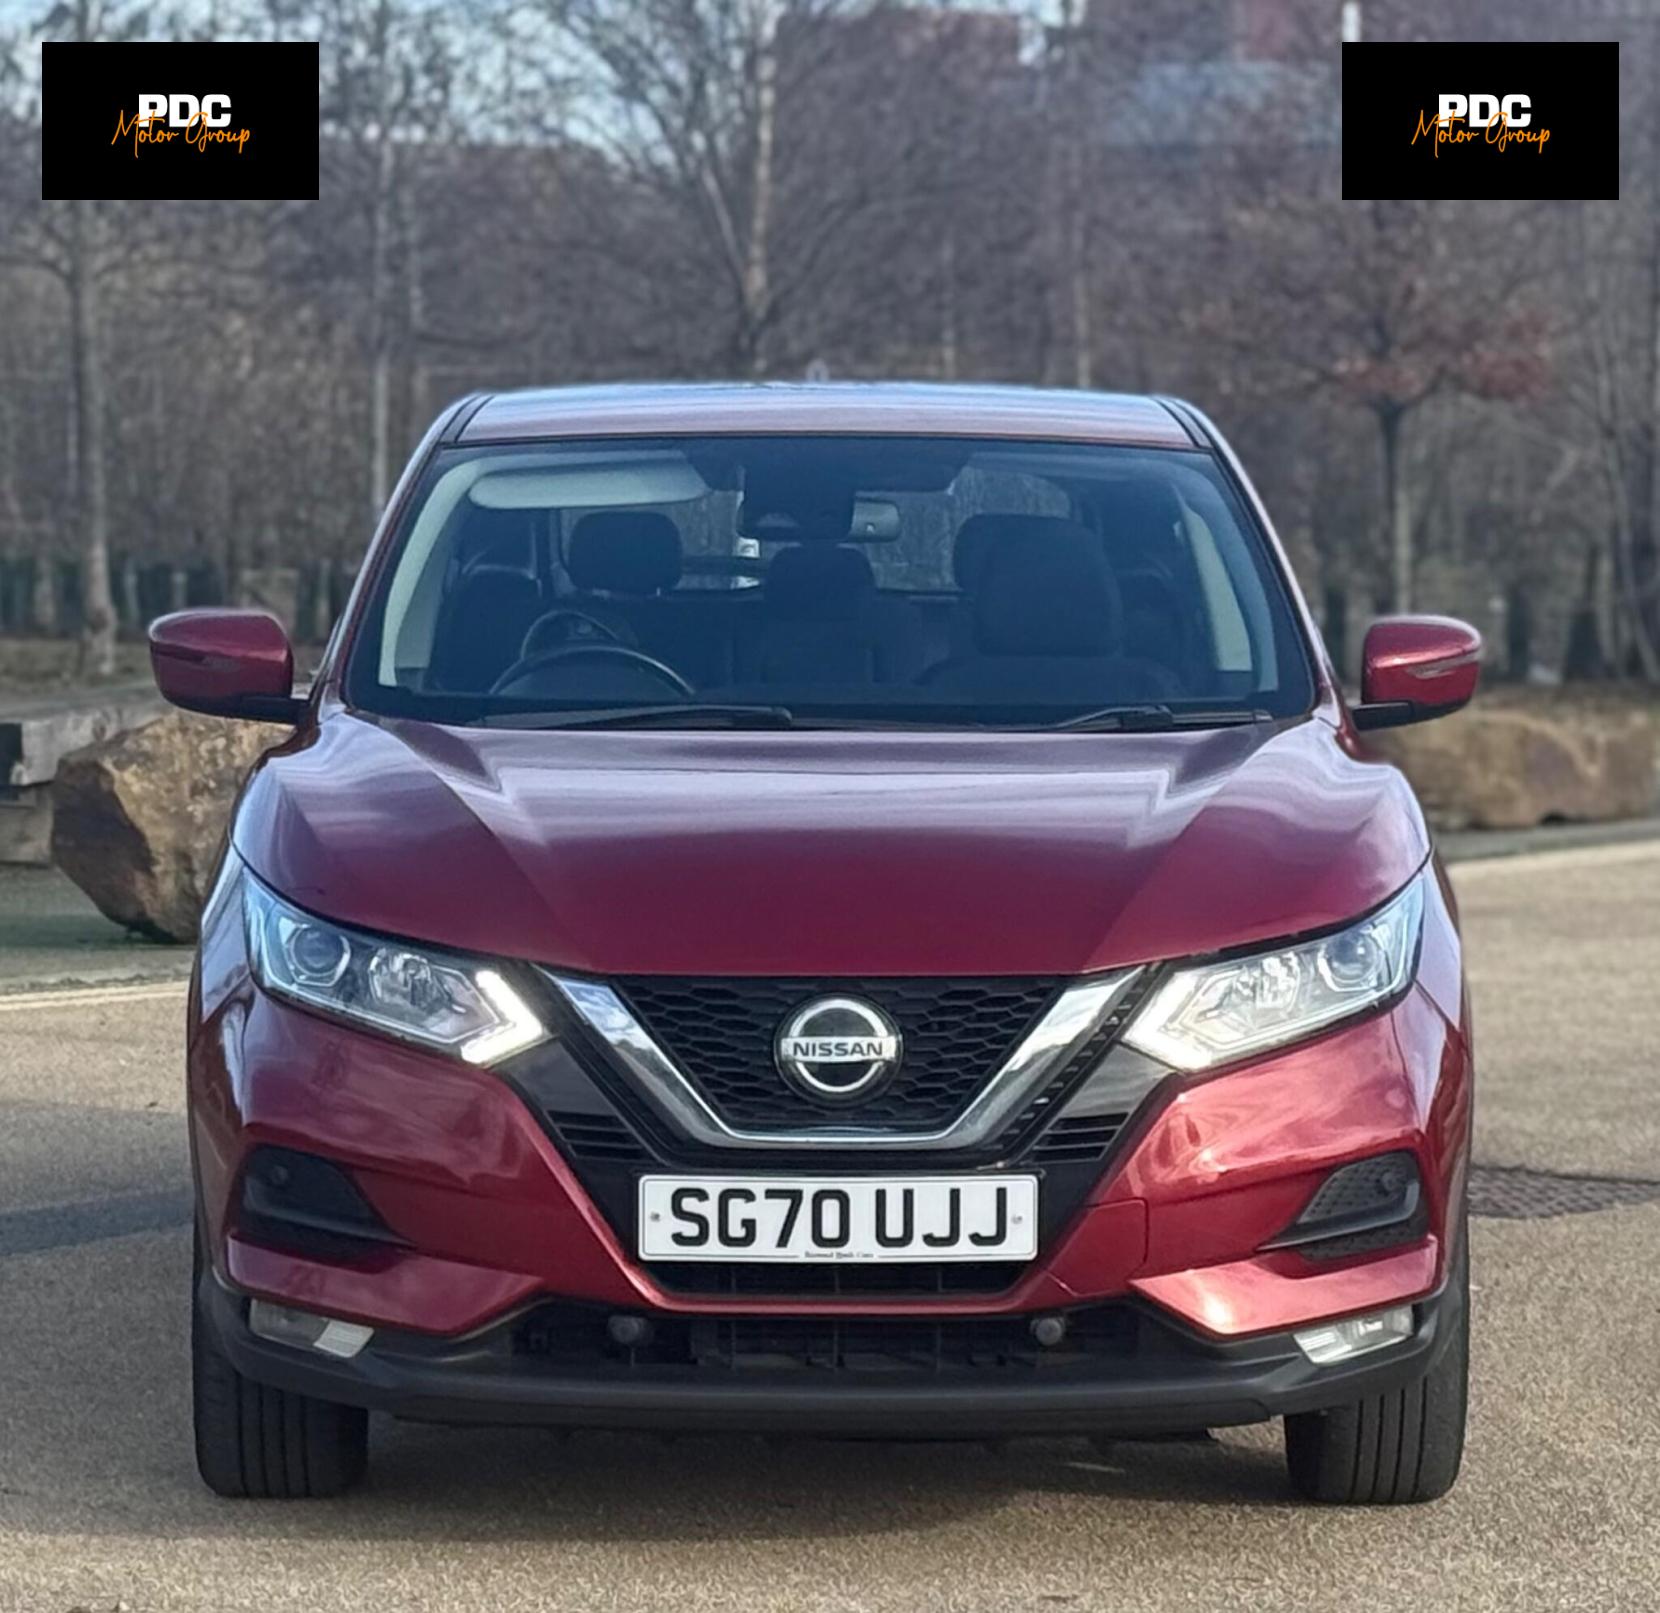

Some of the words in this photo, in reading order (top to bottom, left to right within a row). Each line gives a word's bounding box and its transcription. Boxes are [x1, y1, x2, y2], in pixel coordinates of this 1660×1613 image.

[793, 1042, 883, 1057] NISSAN
[670, 1187, 850, 1248] SG70
[874, 1186, 1007, 1248] UJJ
